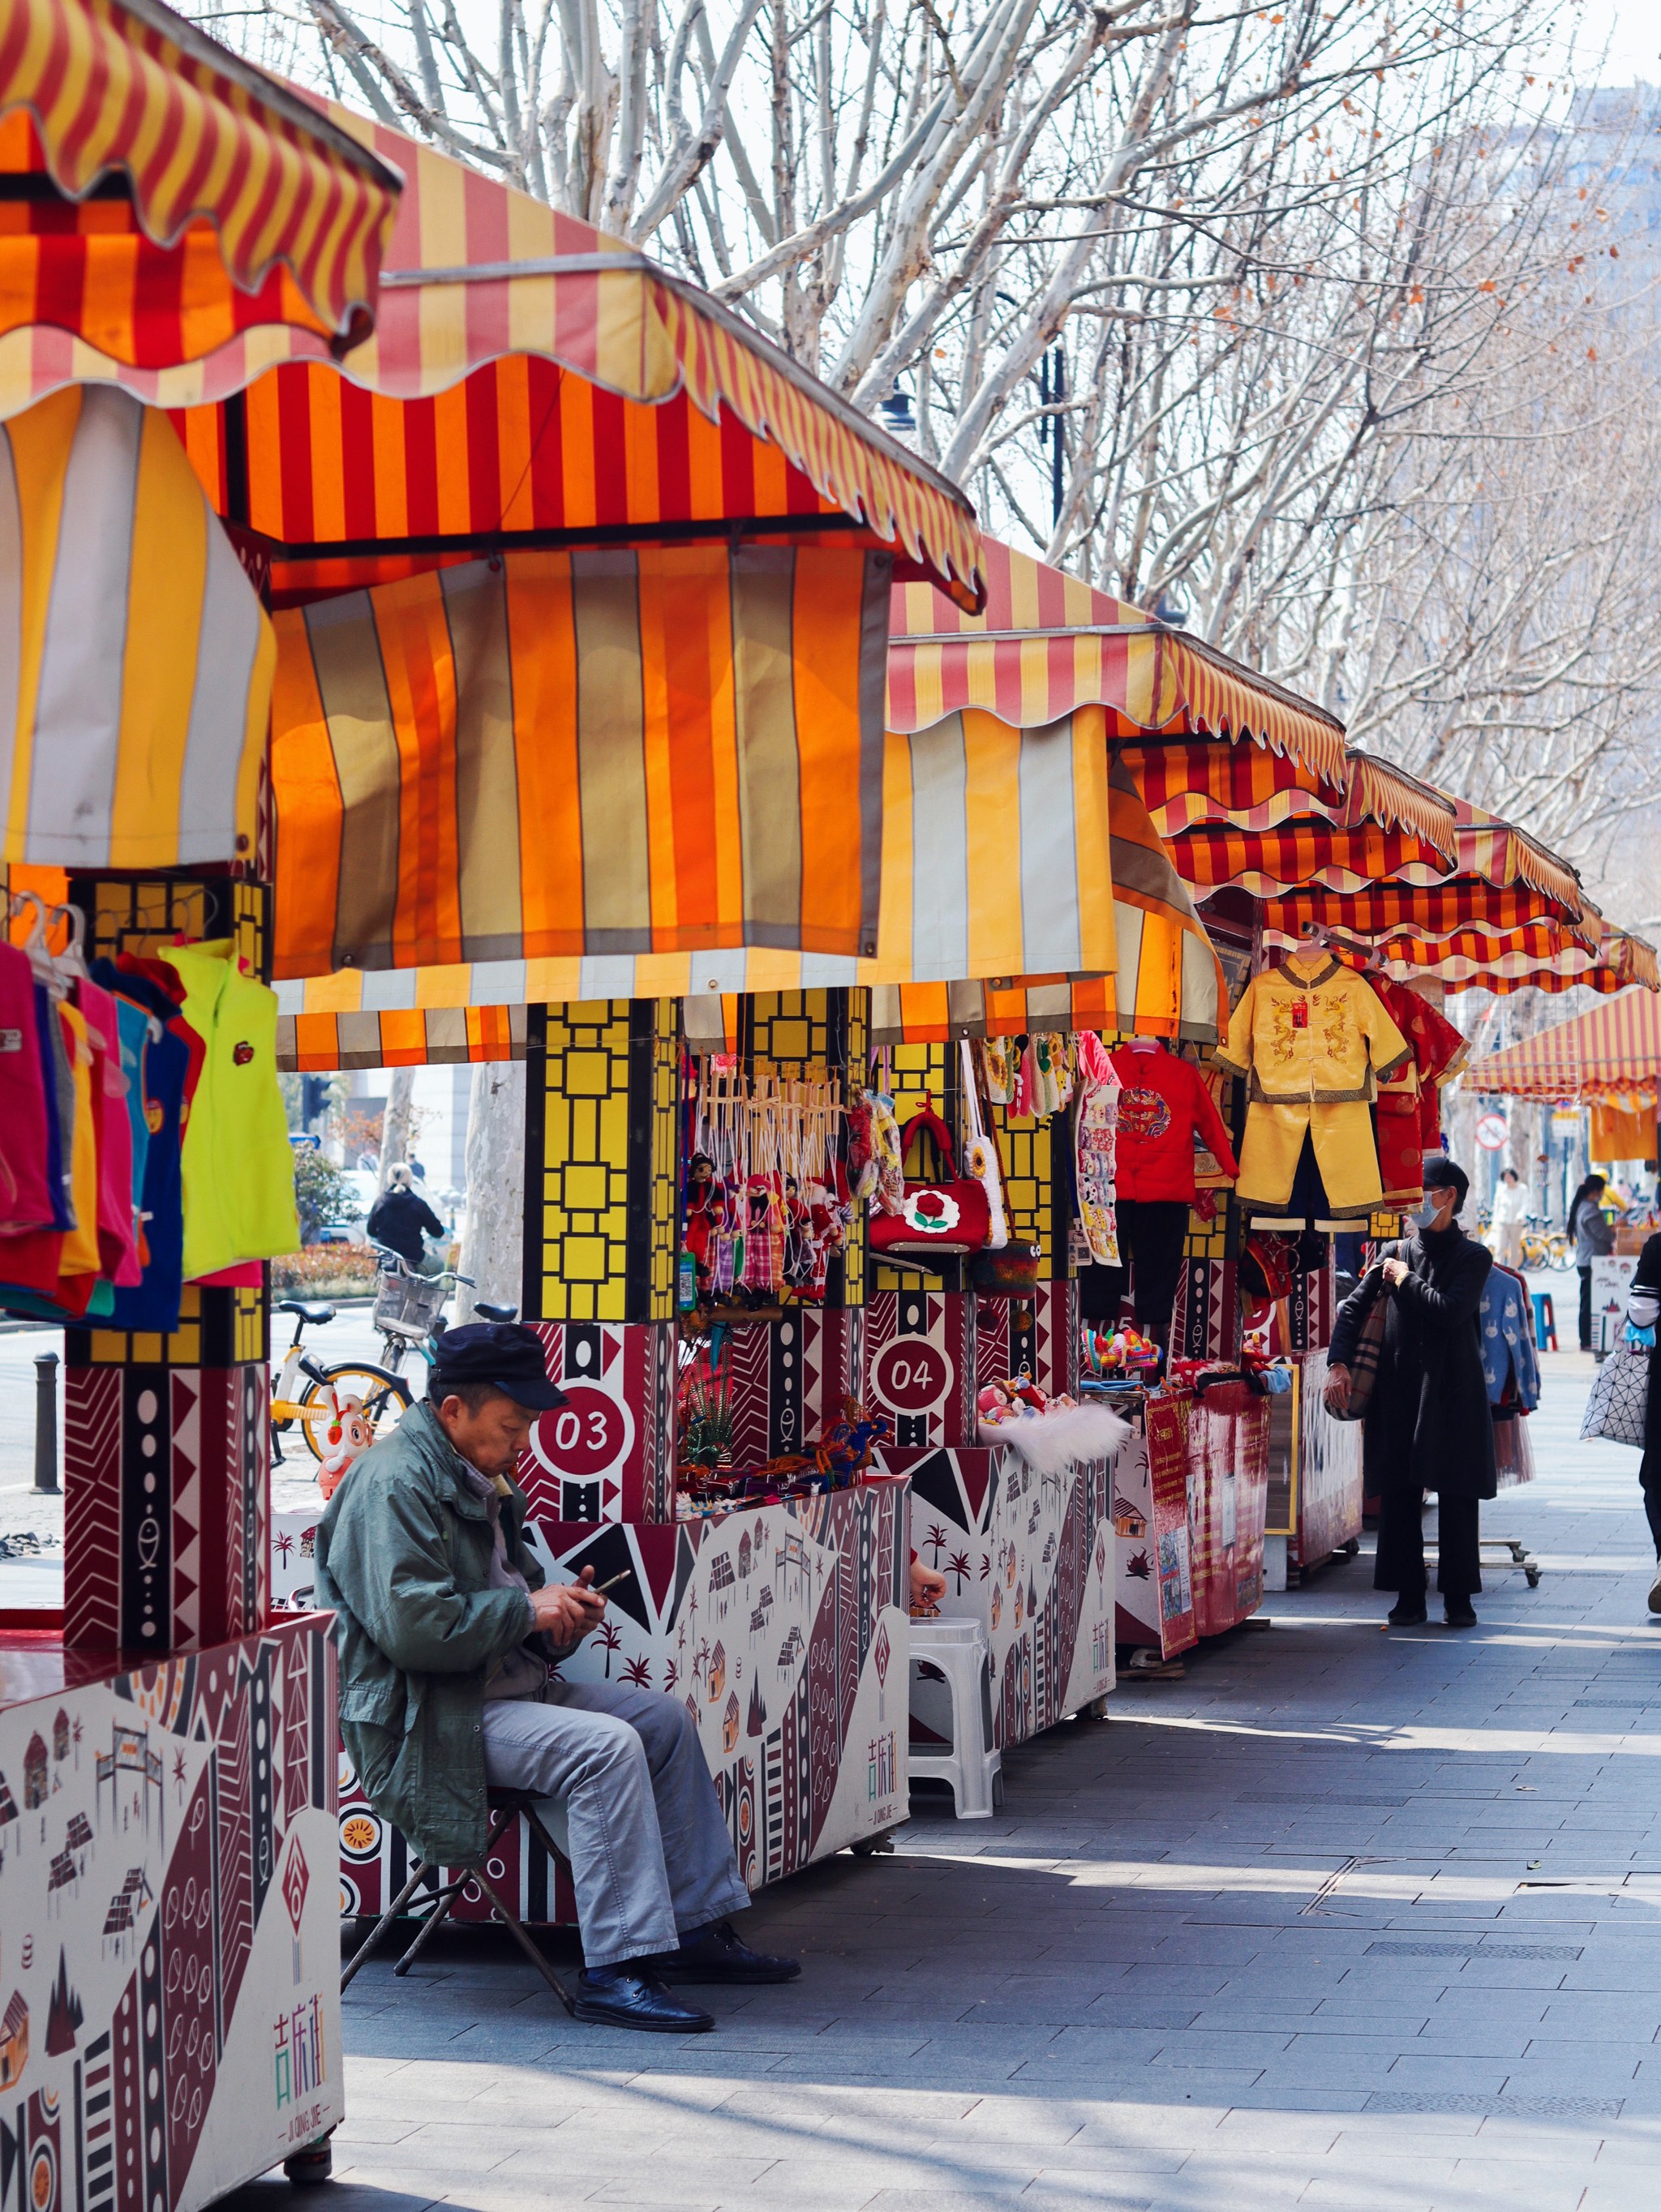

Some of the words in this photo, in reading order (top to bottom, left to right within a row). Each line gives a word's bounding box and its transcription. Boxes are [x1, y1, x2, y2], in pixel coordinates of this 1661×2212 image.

[891, 1360, 934, 1391] 04
[555, 1411, 607, 1451] 03
[868, 1730, 897, 1803] 吉庆街
[273, 1991, 326, 2111] 吉庆街
[288, 2120, 294, 2142] JI
[294, 2110, 310, 2138] QING
[311, 2103, 321, 2128] JIE
